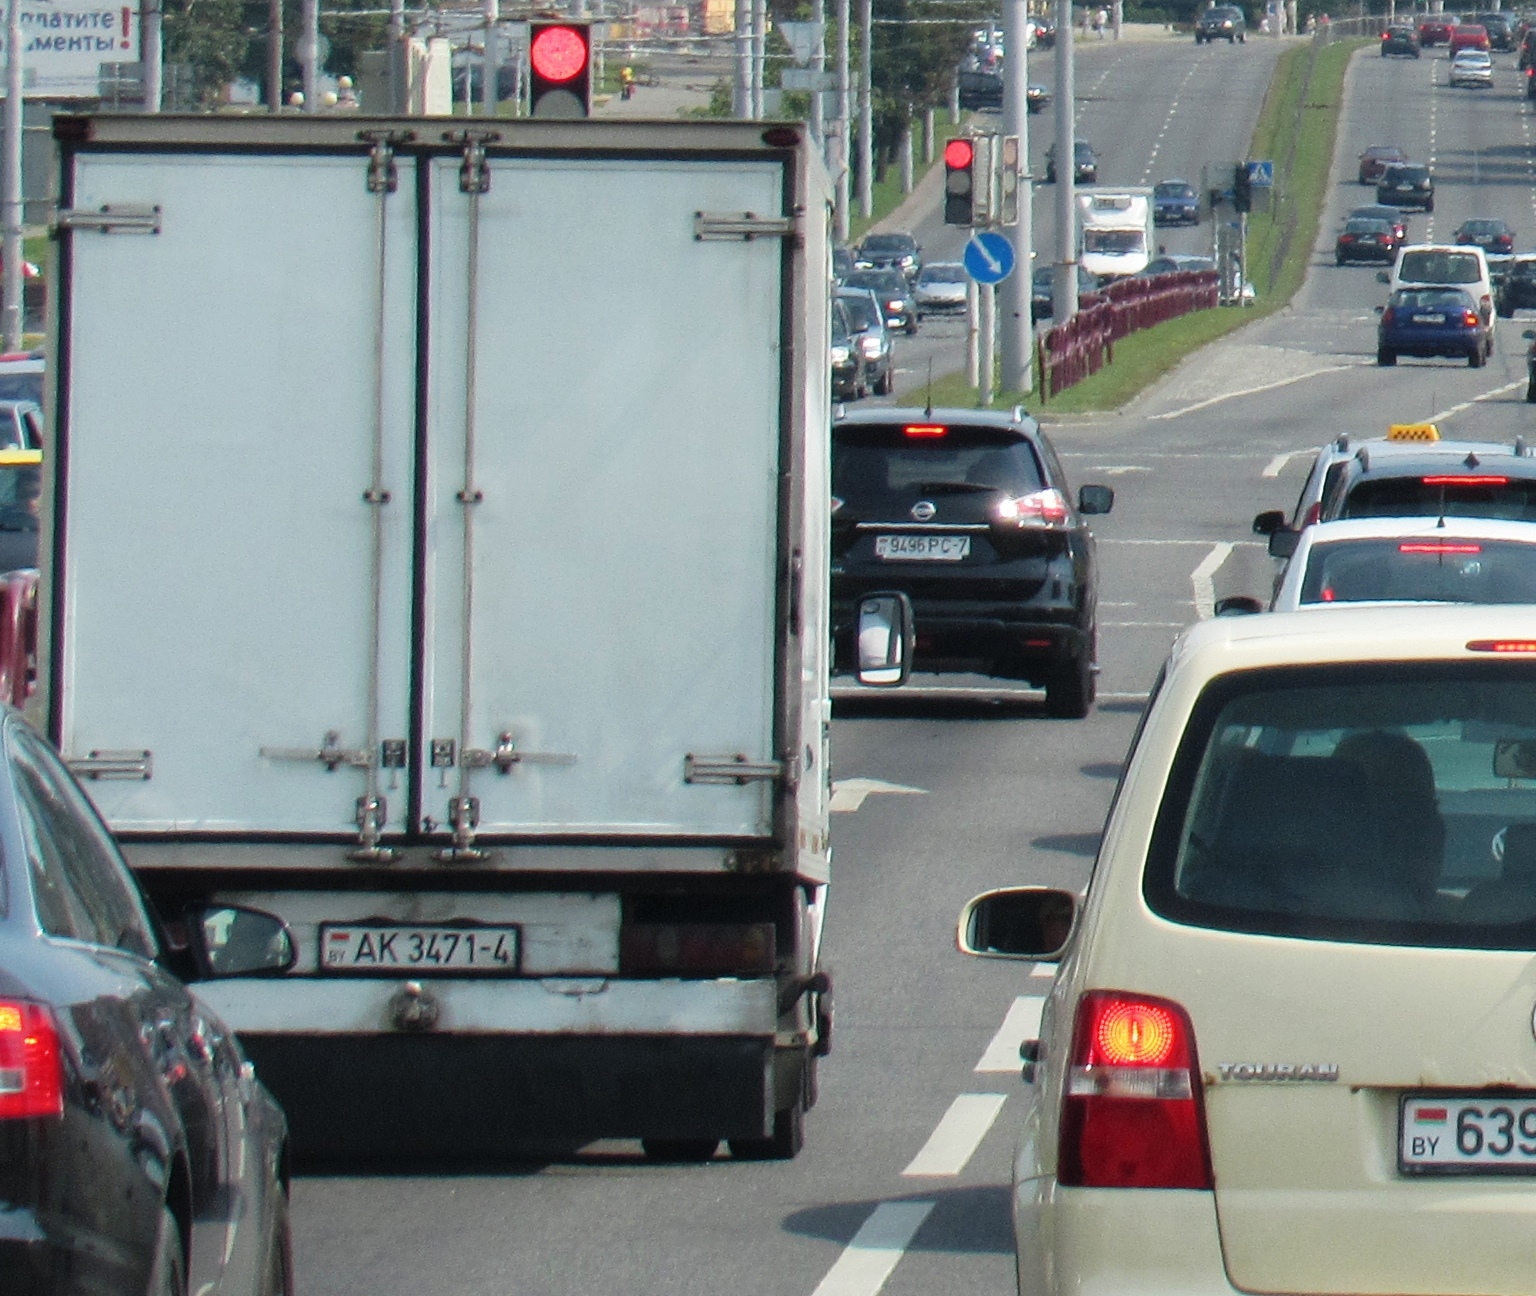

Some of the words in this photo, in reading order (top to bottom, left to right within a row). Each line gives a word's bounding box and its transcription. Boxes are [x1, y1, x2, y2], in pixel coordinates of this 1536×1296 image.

[353, 932, 400, 963] AK
[408, 932, 510, 964] 3471-4
[1411, 1136, 1441, 1157] BY
